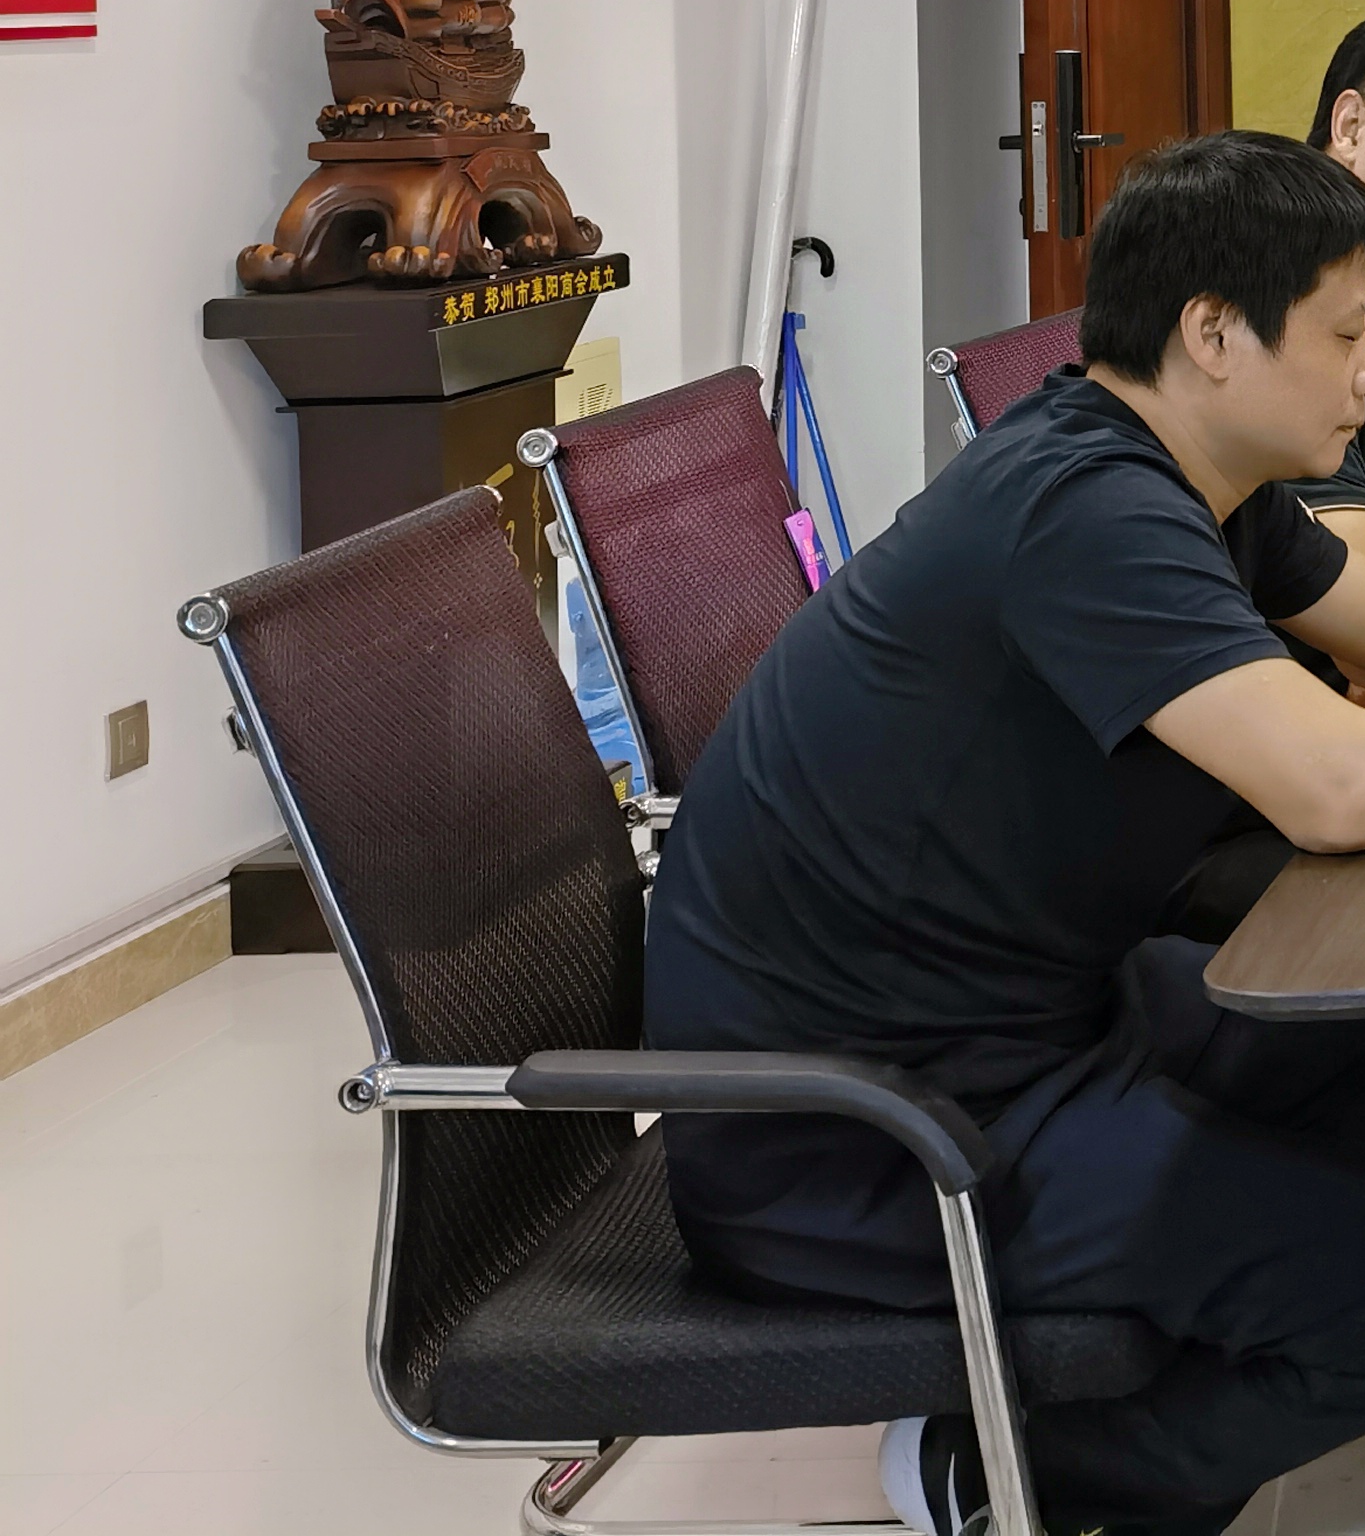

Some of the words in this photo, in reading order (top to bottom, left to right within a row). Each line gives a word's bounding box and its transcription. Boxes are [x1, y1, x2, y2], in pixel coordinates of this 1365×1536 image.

[443, 292, 476, 325] 恭贺
[484, 265, 616, 314] 郑州市襄阳商会成立
